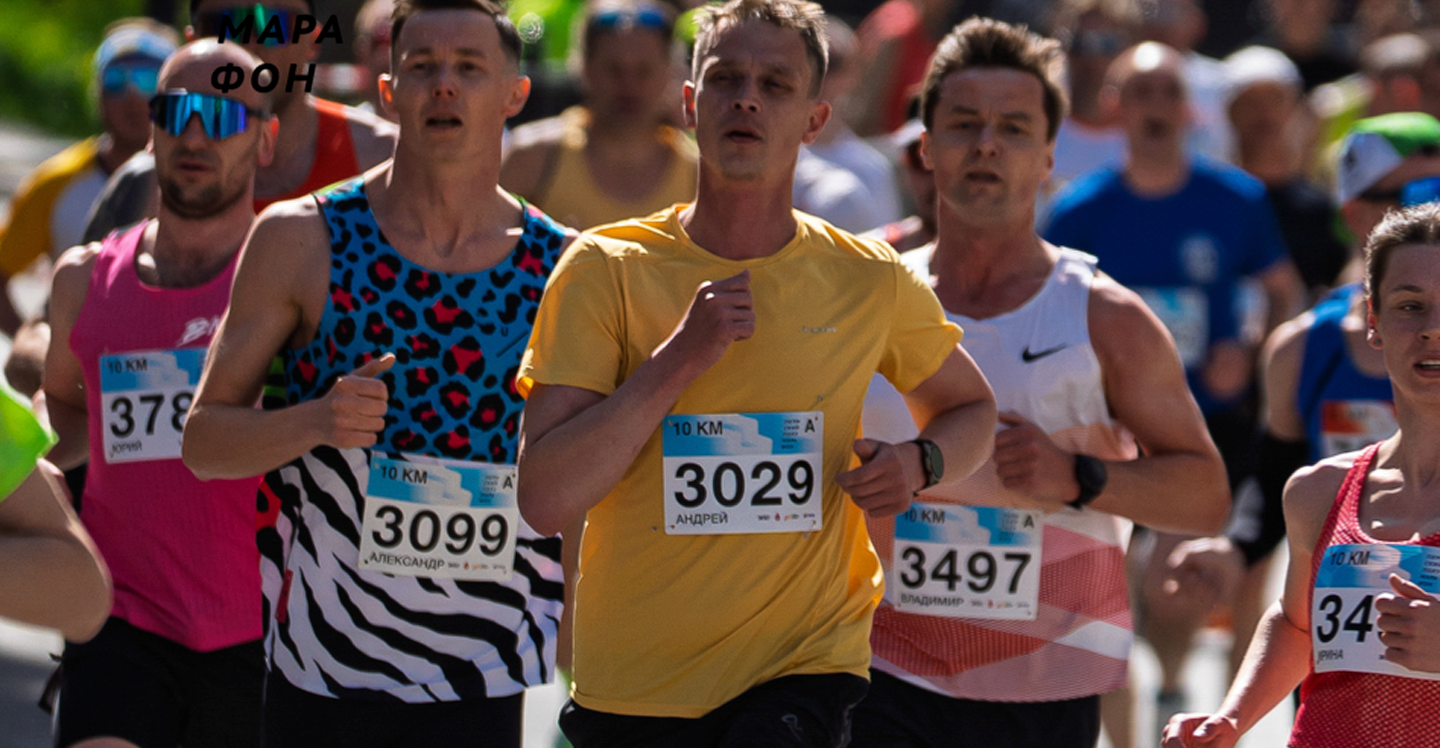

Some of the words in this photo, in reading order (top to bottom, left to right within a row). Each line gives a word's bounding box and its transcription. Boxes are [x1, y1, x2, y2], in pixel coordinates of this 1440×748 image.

[108, 361, 122, 374] 10
[672, 421, 692, 436] 10
[380, 466, 398, 481] 10
[674, 459, 814, 508] 3029
[676, 511, 728, 526] АНДРЕЙ
[371, 505, 510, 558] 3099
[370, 553, 445, 570] АЛЕКСАНДР
[1330, 551, 1347, 566] 10
[901, 546, 1032, 595] 3497
